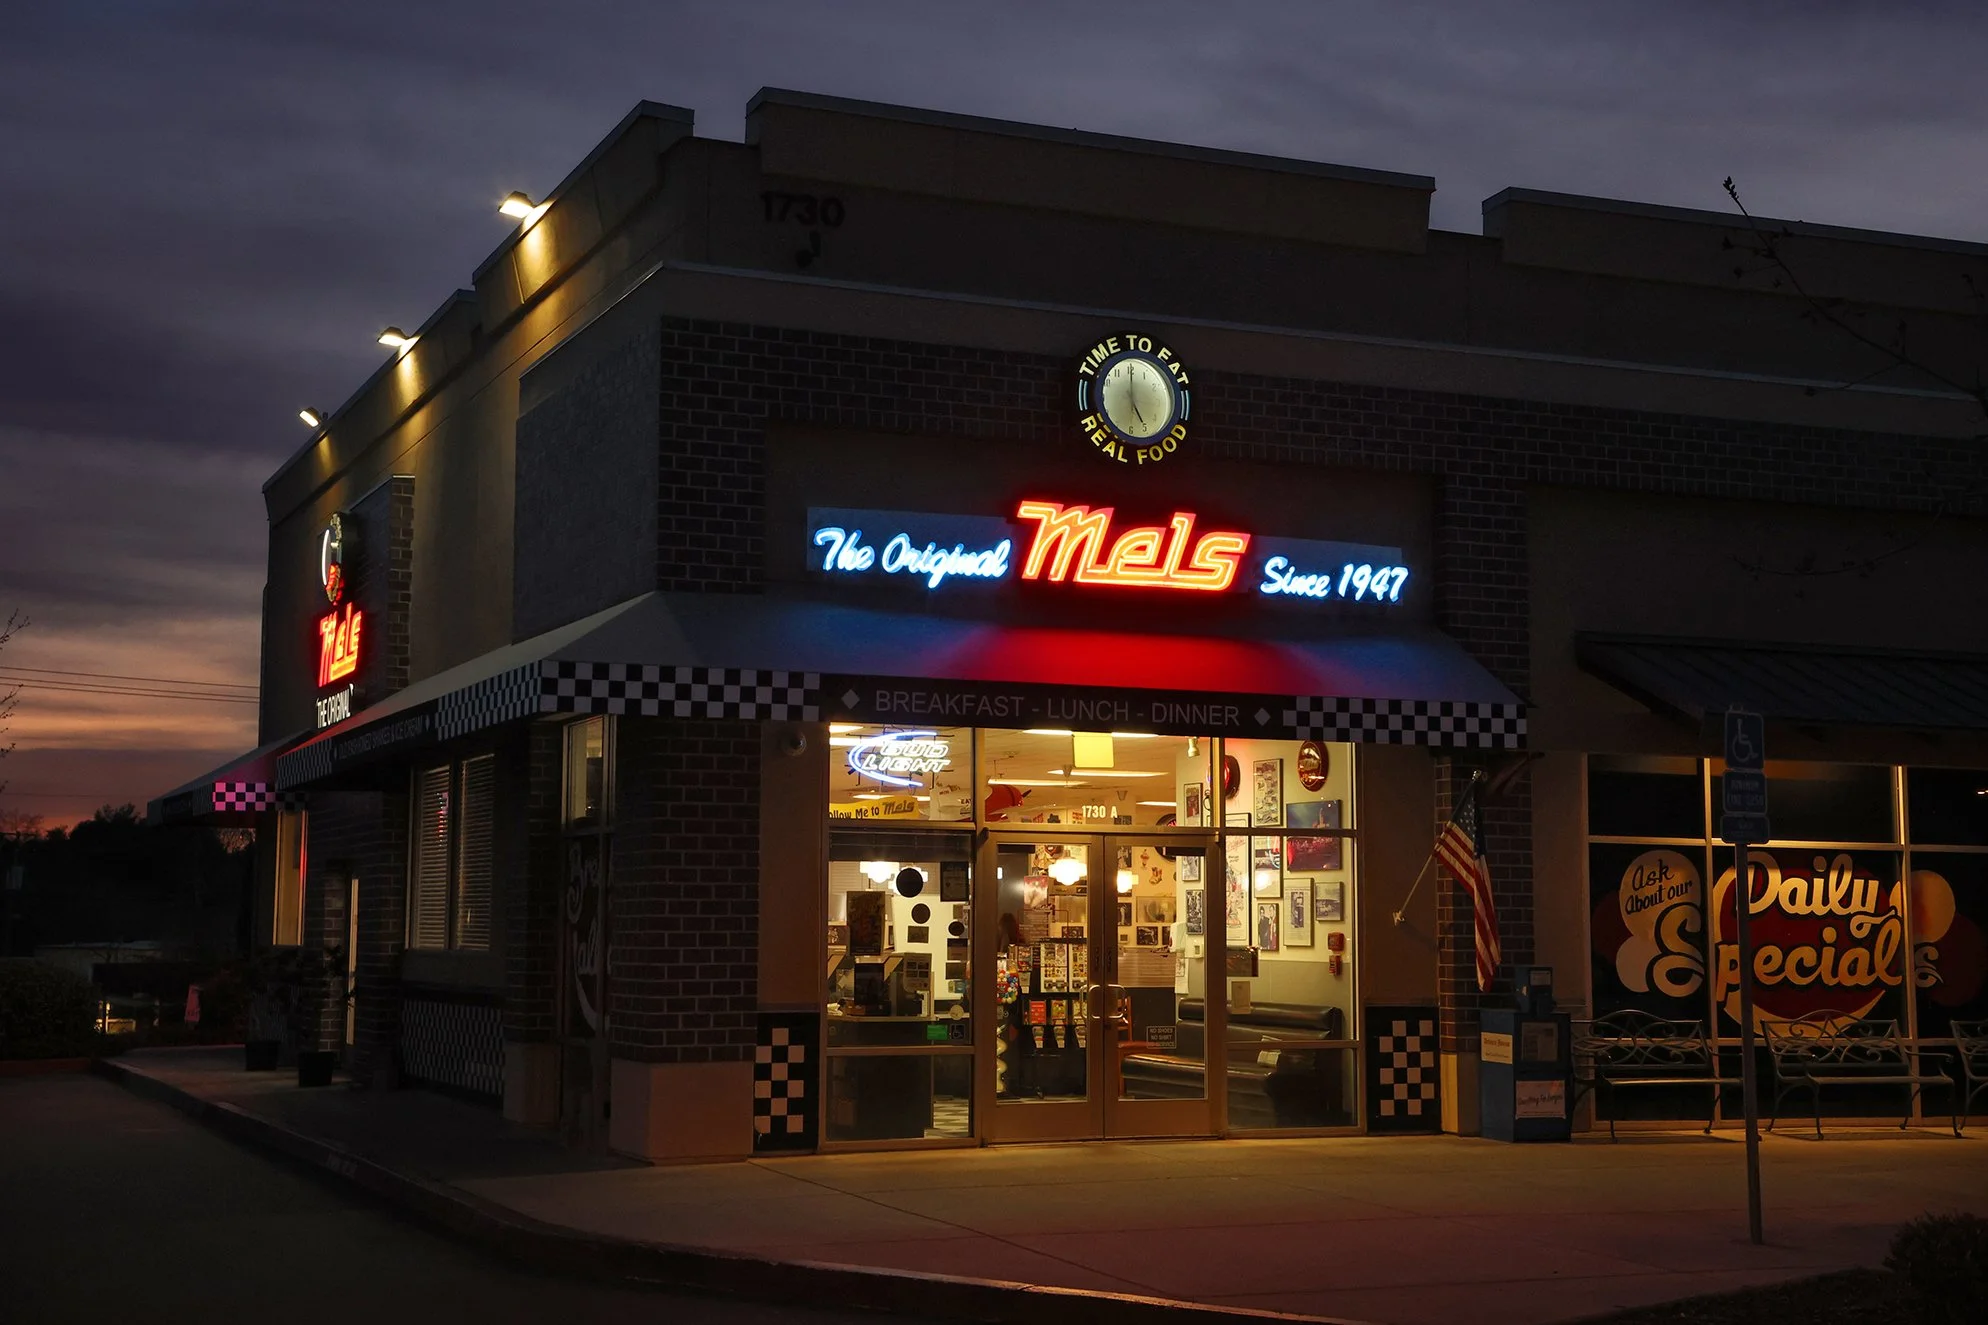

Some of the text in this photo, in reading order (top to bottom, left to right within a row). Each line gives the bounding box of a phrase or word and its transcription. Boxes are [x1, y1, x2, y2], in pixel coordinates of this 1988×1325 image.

[761, 191, 845, 227] 1730
[1079, 334, 1189, 385] TIME TO EAT
[1081, 415, 1187, 465] REAL FOOD
[816, 500, 1409, 602] The Original Mels Since 1947
[319, 602, 361, 687] Mels
[876, 690, 1025, 717] BREAKFAST
[1047, 698, 1129, 722] LUNCH
[1152, 702, 1240, 726] DINNER
[862, 754, 951, 773] LIGHT
[880, 741, 949, 758] BUD
[829, 800, 914, 819] ollow Me to Mels
[1082, 805, 1106, 818] 1730
[1111, 805, 1118, 818] A
[1632, 859, 1675, 891] Ask
[1625, 880, 1693, 915] About our
[1713, 852, 1898, 939] Daily
[1650, 903, 1945, 1003] Specials
